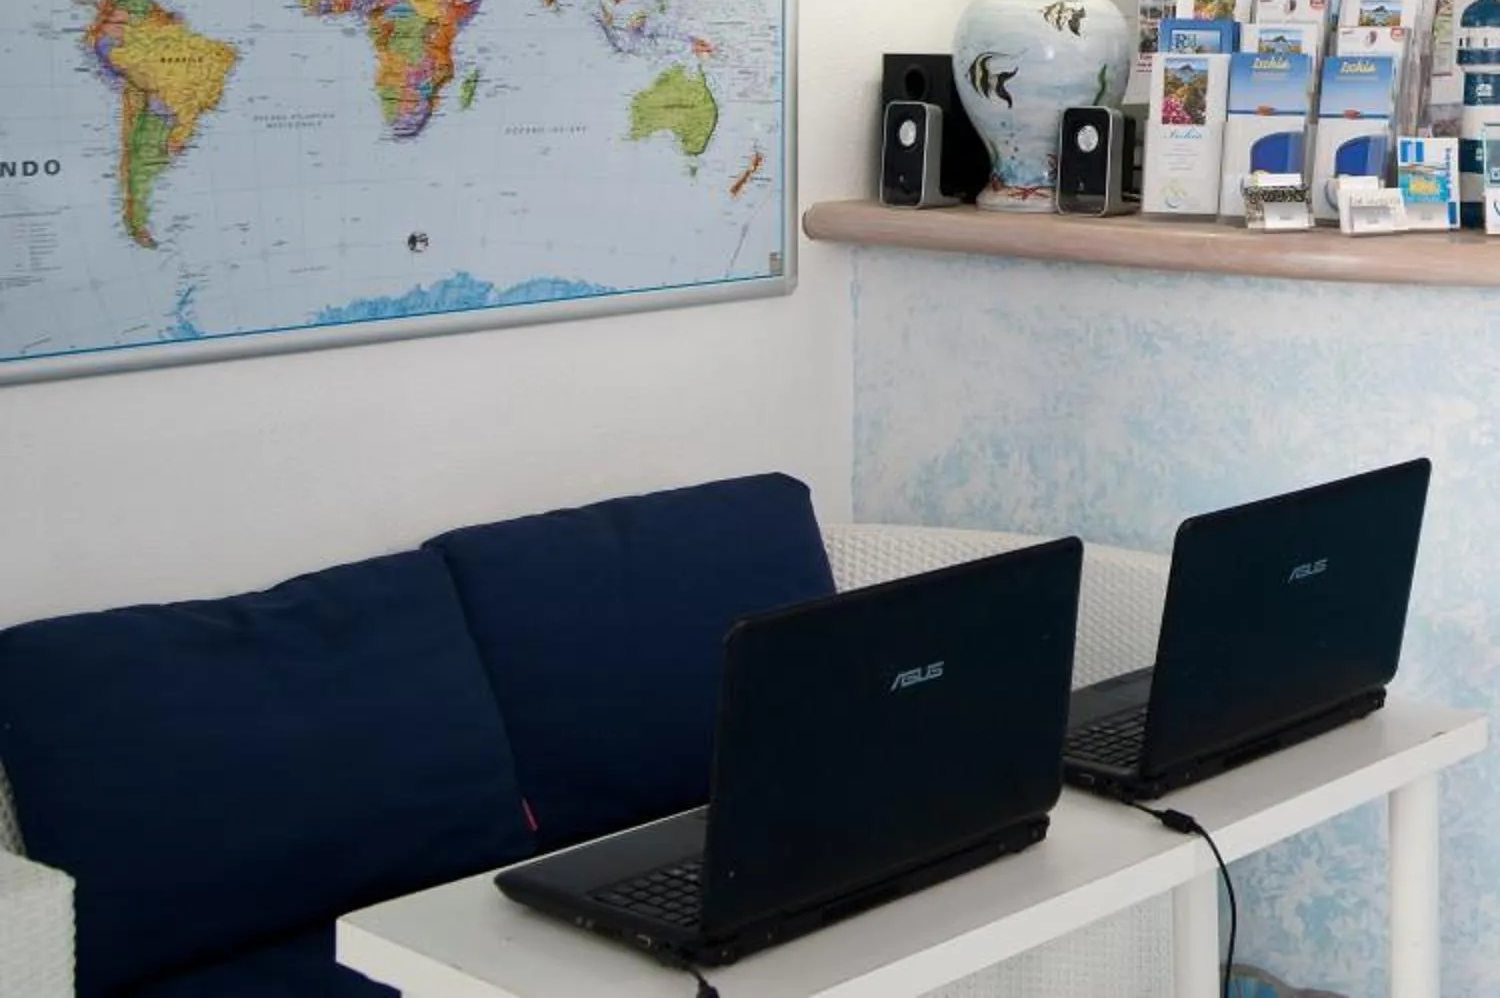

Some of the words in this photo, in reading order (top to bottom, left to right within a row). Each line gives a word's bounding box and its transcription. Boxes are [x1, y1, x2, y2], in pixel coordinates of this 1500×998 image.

[0, 159, 61, 178] NDO
[1287, 557, 1329, 583] ASUS
[889, 660, 945, 692] ASUS
